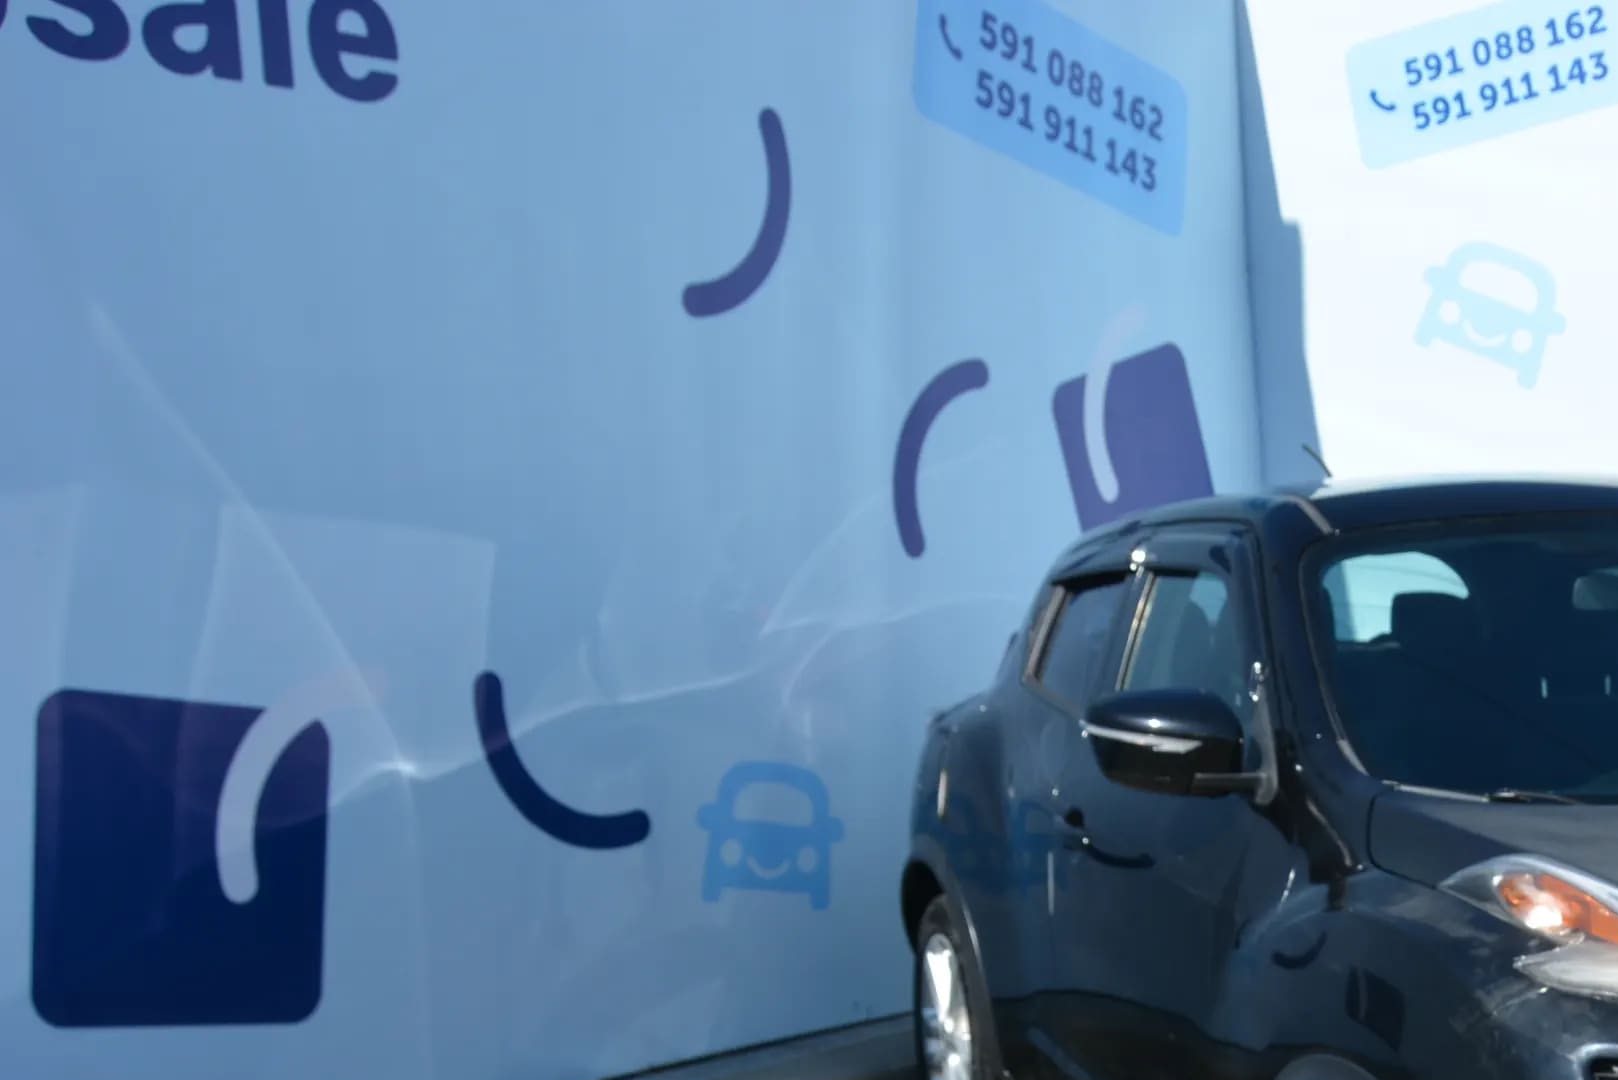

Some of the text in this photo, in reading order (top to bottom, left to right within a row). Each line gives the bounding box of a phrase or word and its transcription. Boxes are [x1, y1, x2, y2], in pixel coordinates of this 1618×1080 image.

[0, 0, 398, 102] sale
[980, 10, 1163, 142] 591 088 162
[1404, 5, 1607, 86] 591 088 162
[1413, 50, 1609, 130] 591 911 143
[975, 69, 1156, 192] 591 911 143
